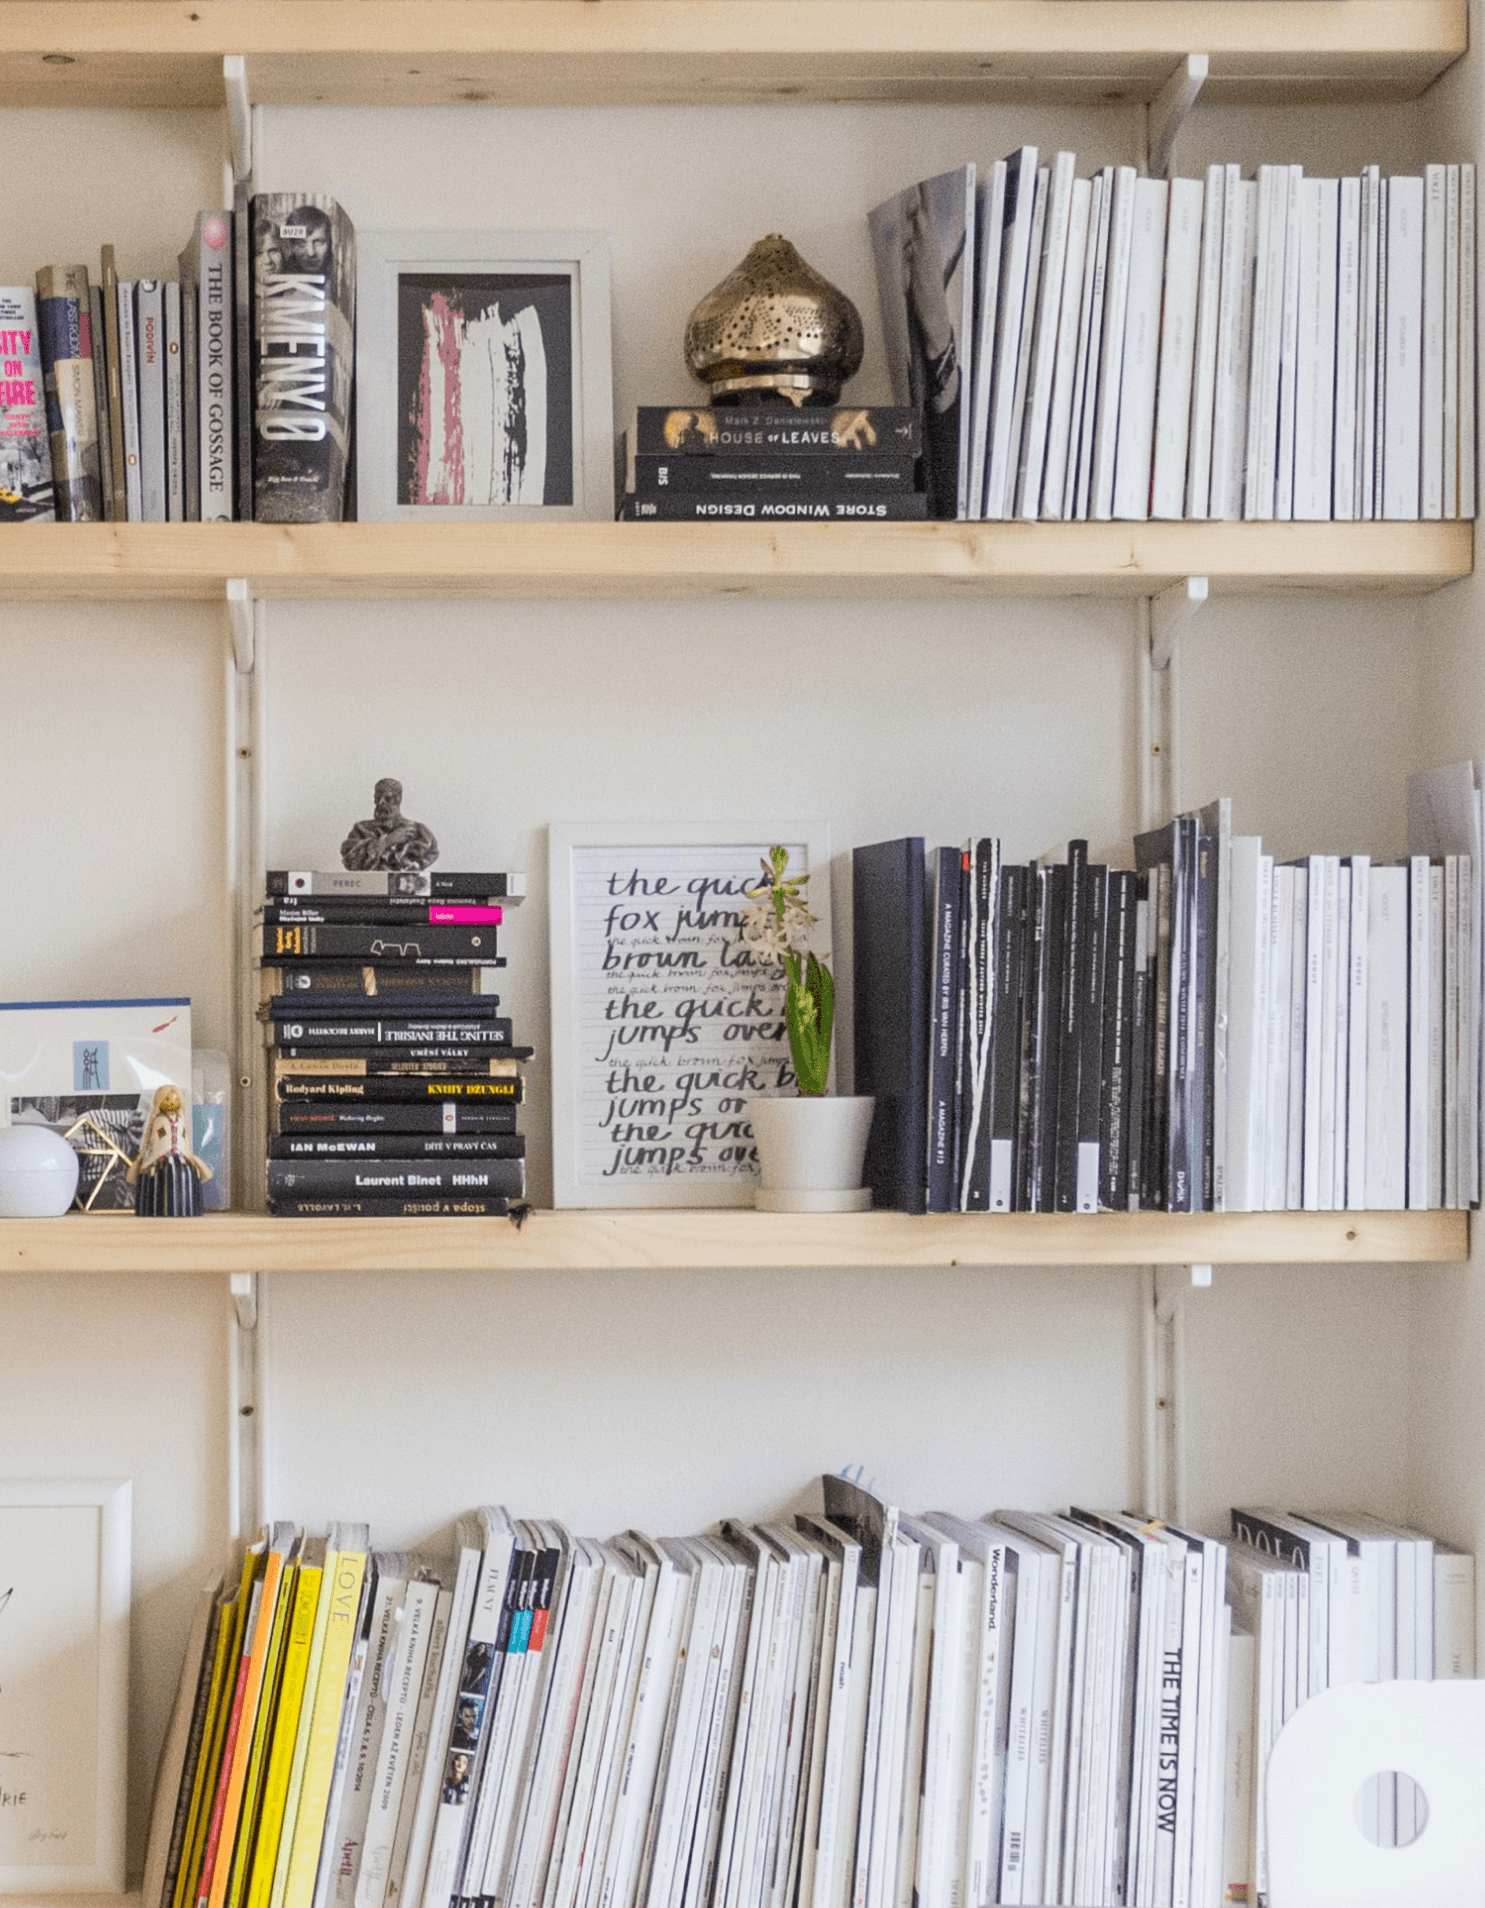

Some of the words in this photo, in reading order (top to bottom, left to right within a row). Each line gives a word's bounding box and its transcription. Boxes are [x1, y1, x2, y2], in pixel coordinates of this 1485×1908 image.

[208, 264, 223, 303] THE
[0, 329, 31, 355] ITY
[208, 310, 223, 367] BOOK
[4, 359, 22, 377] ON
[208, 372, 223, 398] OF
[208, 404, 223, 493] GOSSAGE
[708, 431, 763, 444] HOUSE
[781, 431, 840, 444] LEAVES
[696, 504, 755, 517] DESIGN
[761, 504, 830, 517] WINDOW
[836, 504, 887, 517] STORE
[333, 879, 361, 888] PEREC
[606, 868, 681, 897] the
[603, 904, 660, 937] fox
[943, 911, 952, 949] MAGAZINE
[602, 941, 707, 970] brown
[942, 952, 950, 984] CURATED
[942, 986, 949, 995] BY
[605, 994, 664, 1020] the
[675, 991, 773, 1036] quick
[940, 1011, 948, 1026] VAN
[349, 1027, 375, 1036] HARRY
[385, 1030, 434, 1042] INVISIBLE
[435, 1030, 459, 1042] THE
[459, 1030, 504, 1042] SELLING
[595, 1024, 701, 1061] jumps
[327, 1084, 364, 1096] Kipling
[605, 1067, 665, 1094] the
[675, 1064, 766, 1102] quick
[599, 1097, 702, 1127] jumps
[610, 1122, 671, 1143] the
[937, 1108, 946, 1147] MAGAZINE
[290, 1142, 313, 1152] IAN
[602, 1144, 704, 1176] jumps
[355, 1175, 405, 1186] Laurent
[407, 1175, 442, 1186] Binet
[452, 1175, 489, 1186] HHhH
[332, 1556, 359, 1625] LOVE
[380, 1608, 391, 1634] VELKÁ
[410, 1607, 422, 1634] VELKÁ
[375, 1635, 386, 1661] KNIHA
[405, 1636, 417, 1663] KNIHA
[369, 1662, 382, 1698] RECEPTŮ
[837, 1661, 846, 1690] noah
[1162, 1647, 1182, 1687] THE
[398, 1665, 412, 1704] RECEPTŮ
[392, 1711, 404, 1739] LEDEN
[1160, 1694, 1180, 1744] TIME
[1159, 1751, 1177, 1770] IS
[1156, 1777, 1176, 1831] NOW
